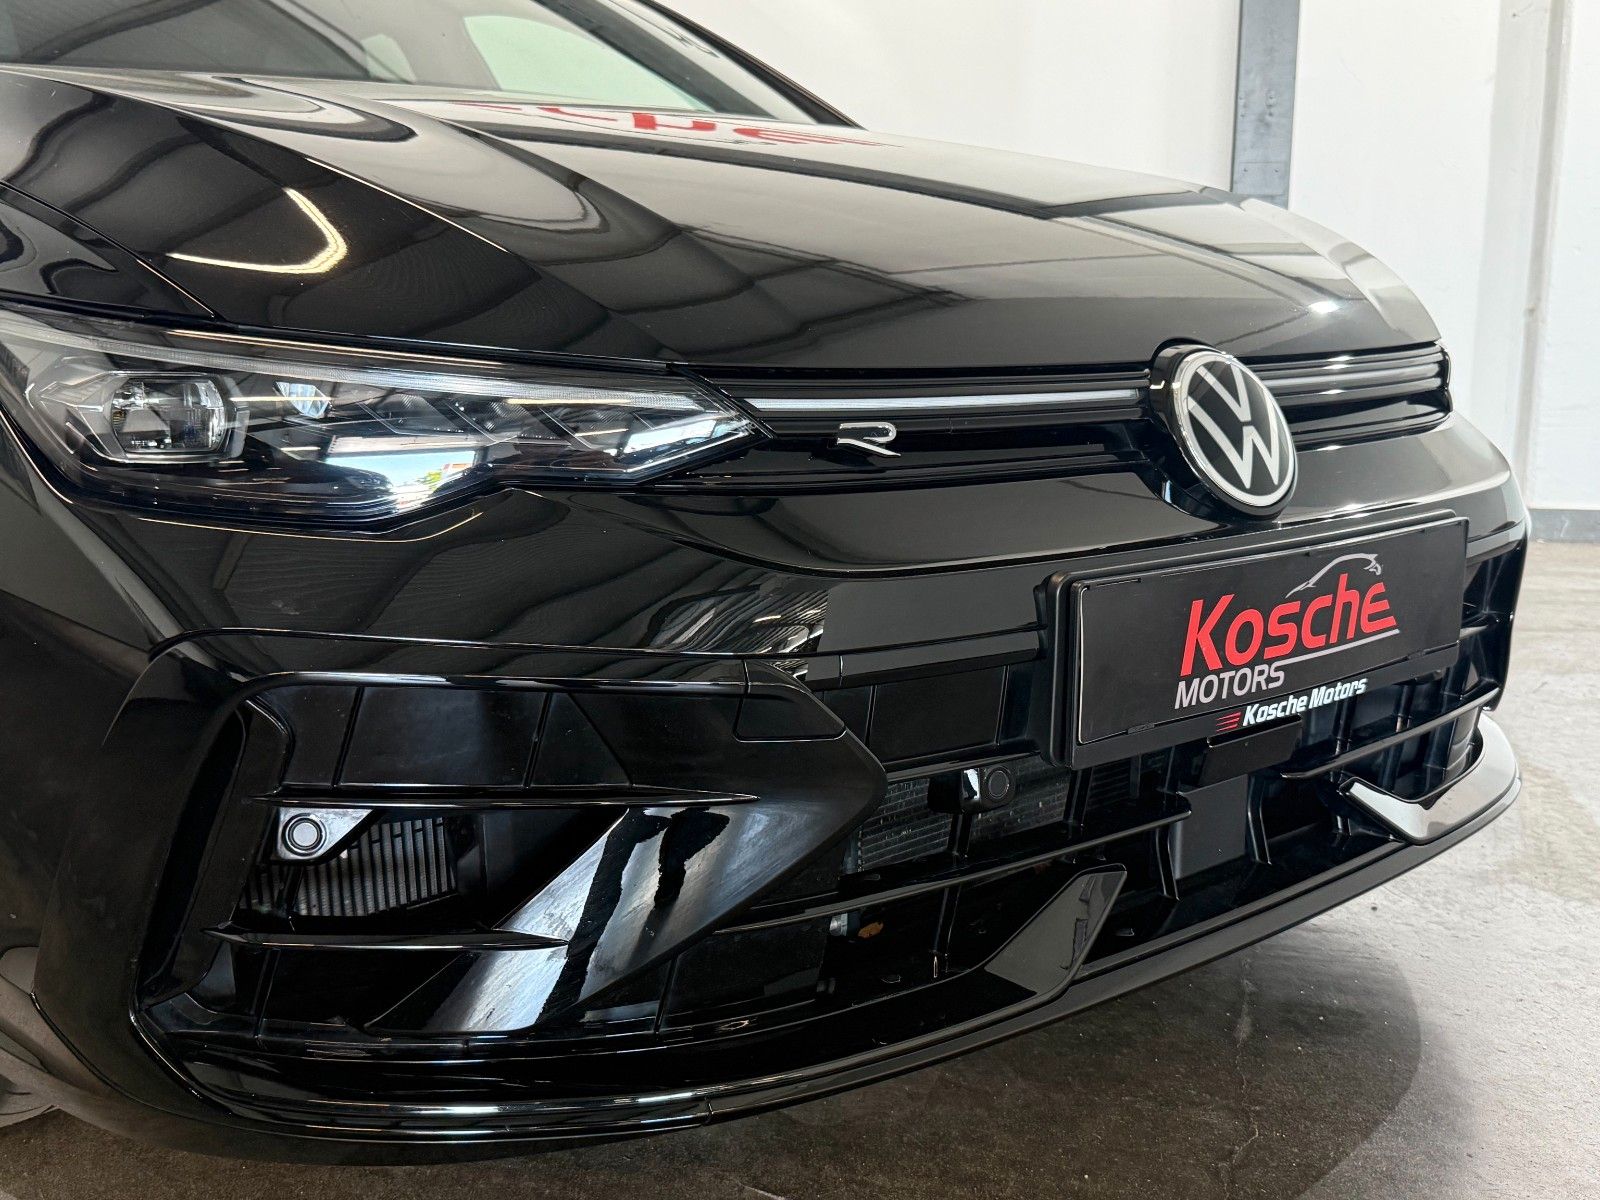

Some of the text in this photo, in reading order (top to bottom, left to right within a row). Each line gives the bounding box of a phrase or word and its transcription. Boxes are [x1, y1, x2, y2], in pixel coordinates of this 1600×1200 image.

[1179, 573, 1397, 677] Kosche
[1174, 660, 1285, 710] MOTORS
[1243, 677, 1368, 727] Kosche Motors
